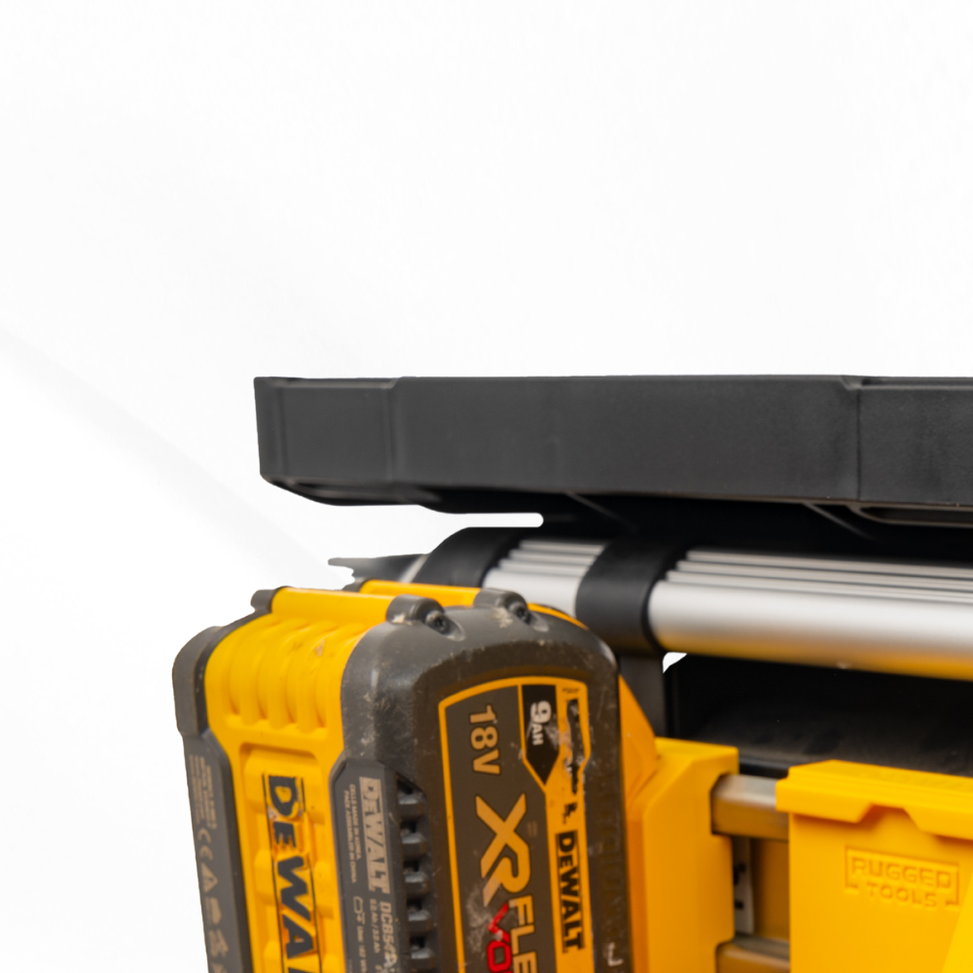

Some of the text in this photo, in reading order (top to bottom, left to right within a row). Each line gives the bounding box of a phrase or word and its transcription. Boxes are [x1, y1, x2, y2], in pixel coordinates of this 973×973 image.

[470, 704, 500, 775] 18V
[475, 793, 531, 908] XR
[852, 856, 951, 889] RUGGED
[866, 881, 937, 907] TOOLS
[380, 901, 397, 968] DCB54
